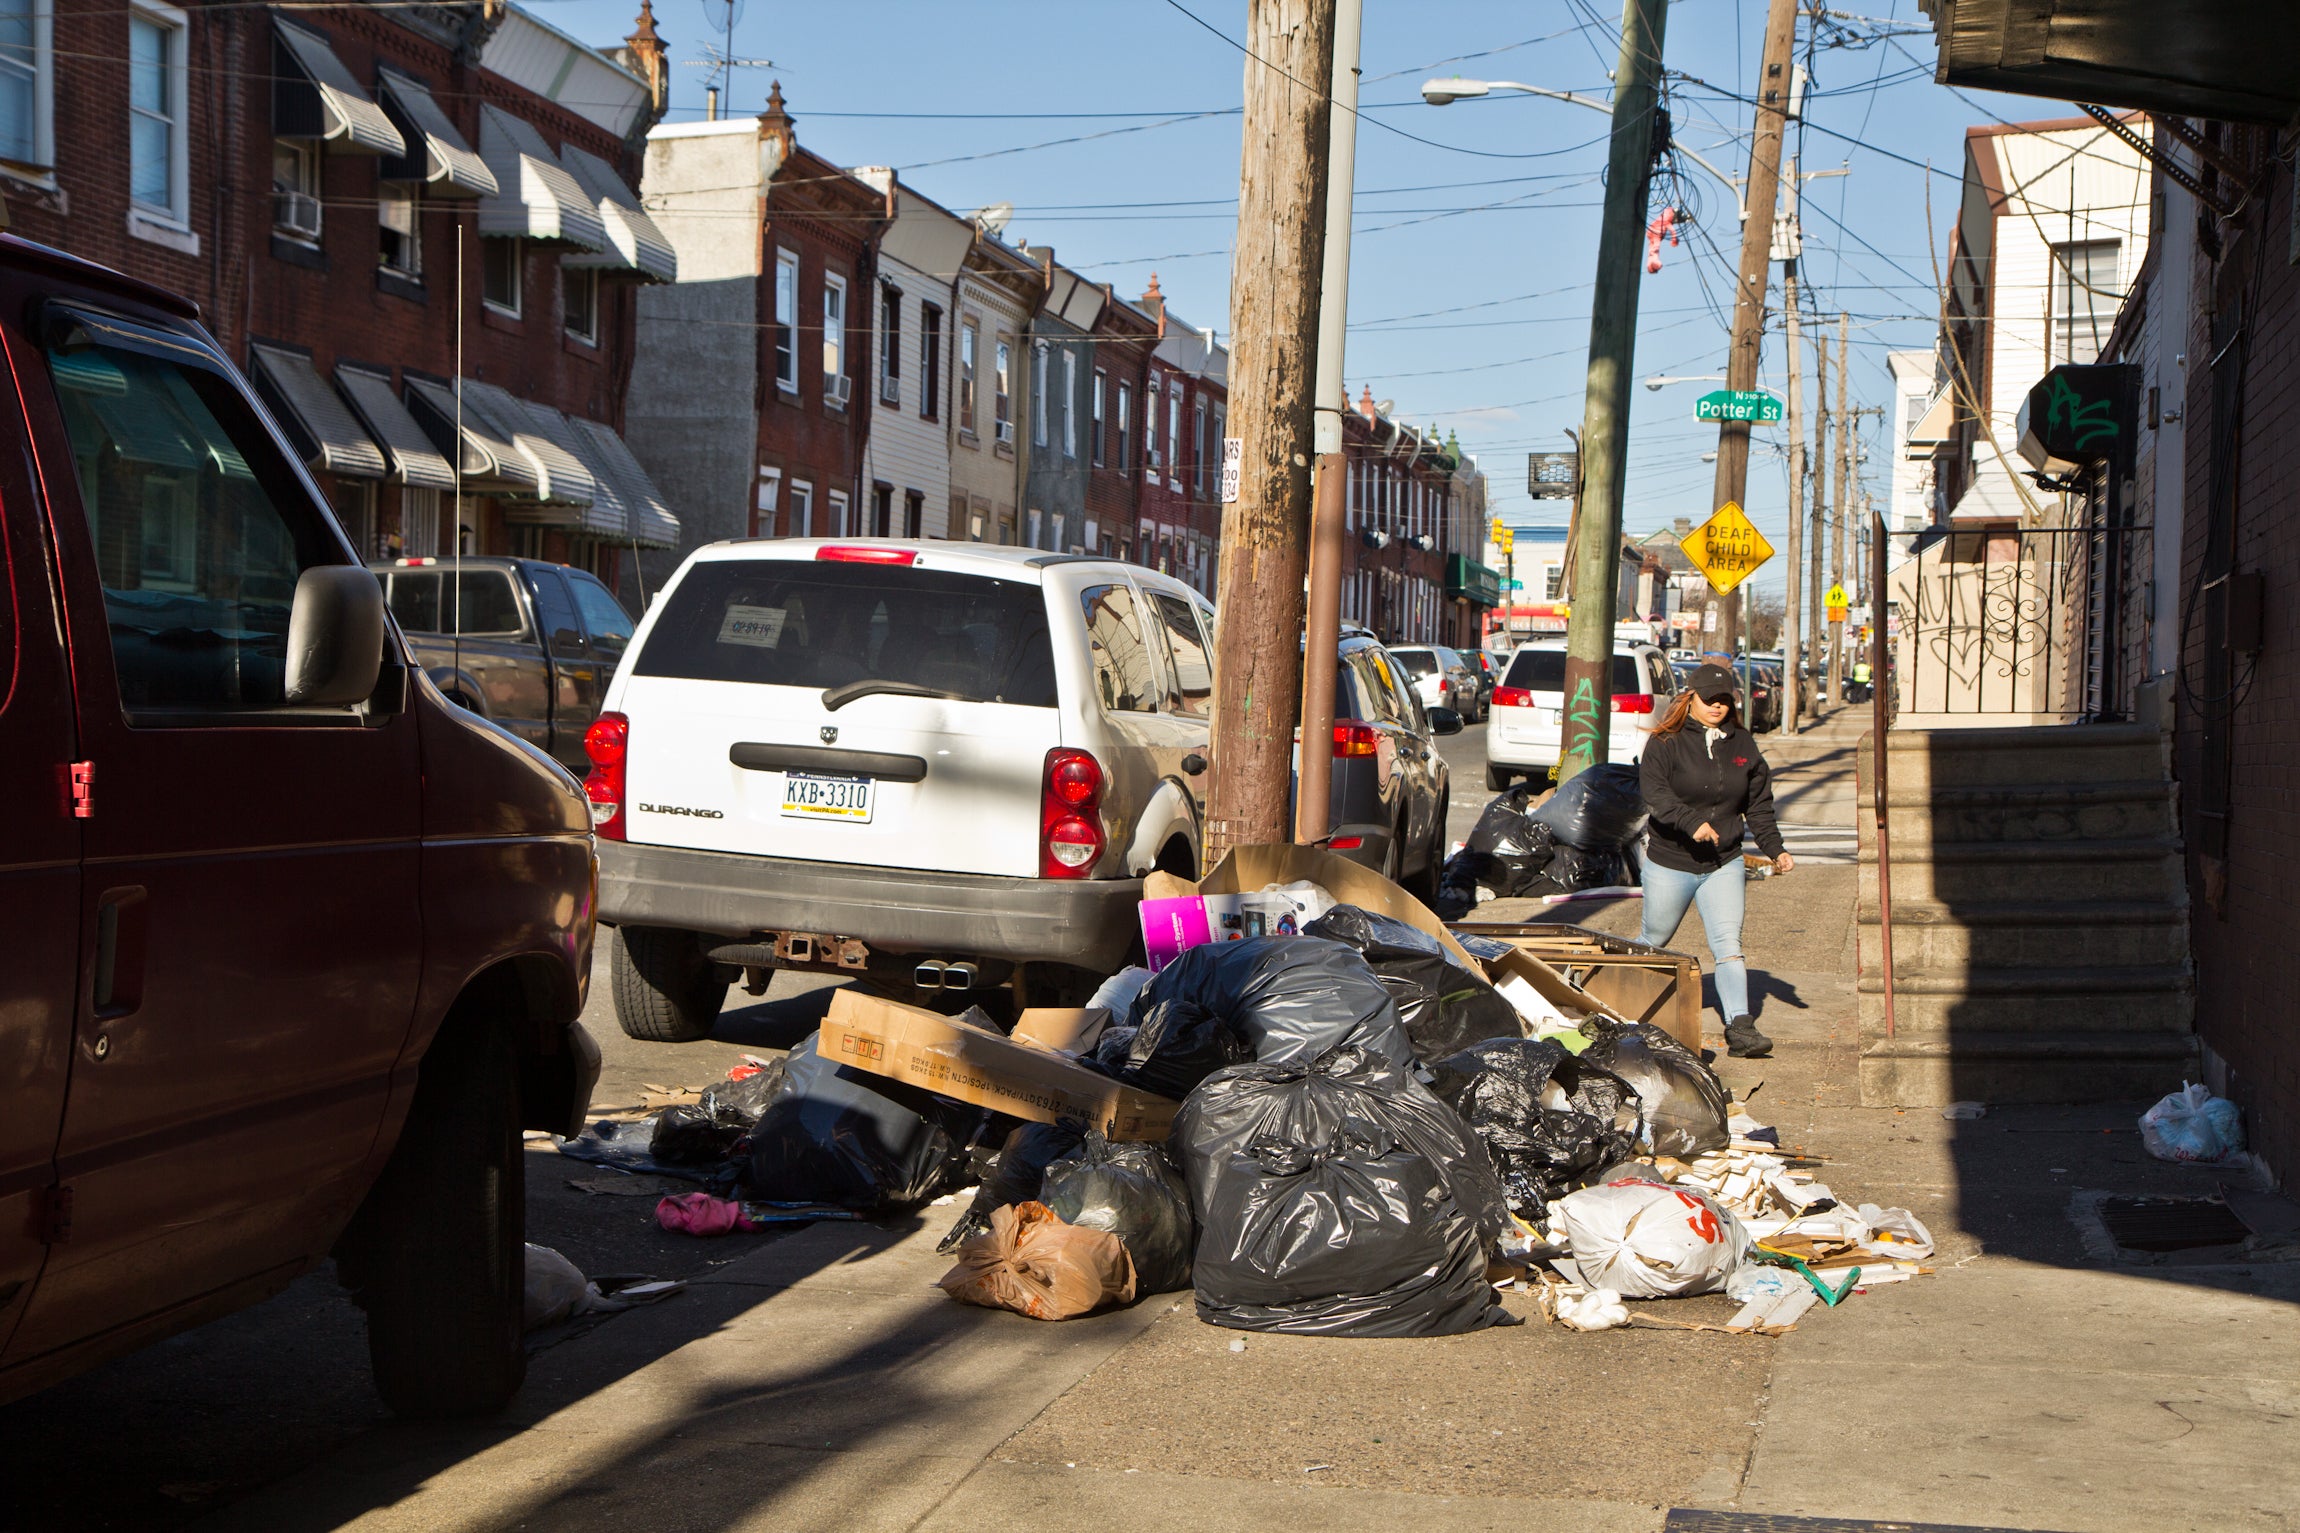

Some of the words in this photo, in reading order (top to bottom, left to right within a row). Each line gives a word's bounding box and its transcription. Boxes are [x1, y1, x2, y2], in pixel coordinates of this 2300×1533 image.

[1699, 400, 1754, 418] Potter
[1762, 405, 1779, 420] St
[1706, 525, 1752, 540] DEAF
[1705, 541, 1751, 557] CHILD
[1705, 558, 1746, 572] AREA
[638, 802, 724, 820] DURANGO
[1036, 1096, 1061, 1113] 2763
[1080, 1109, 1099, 1122] ITEM
